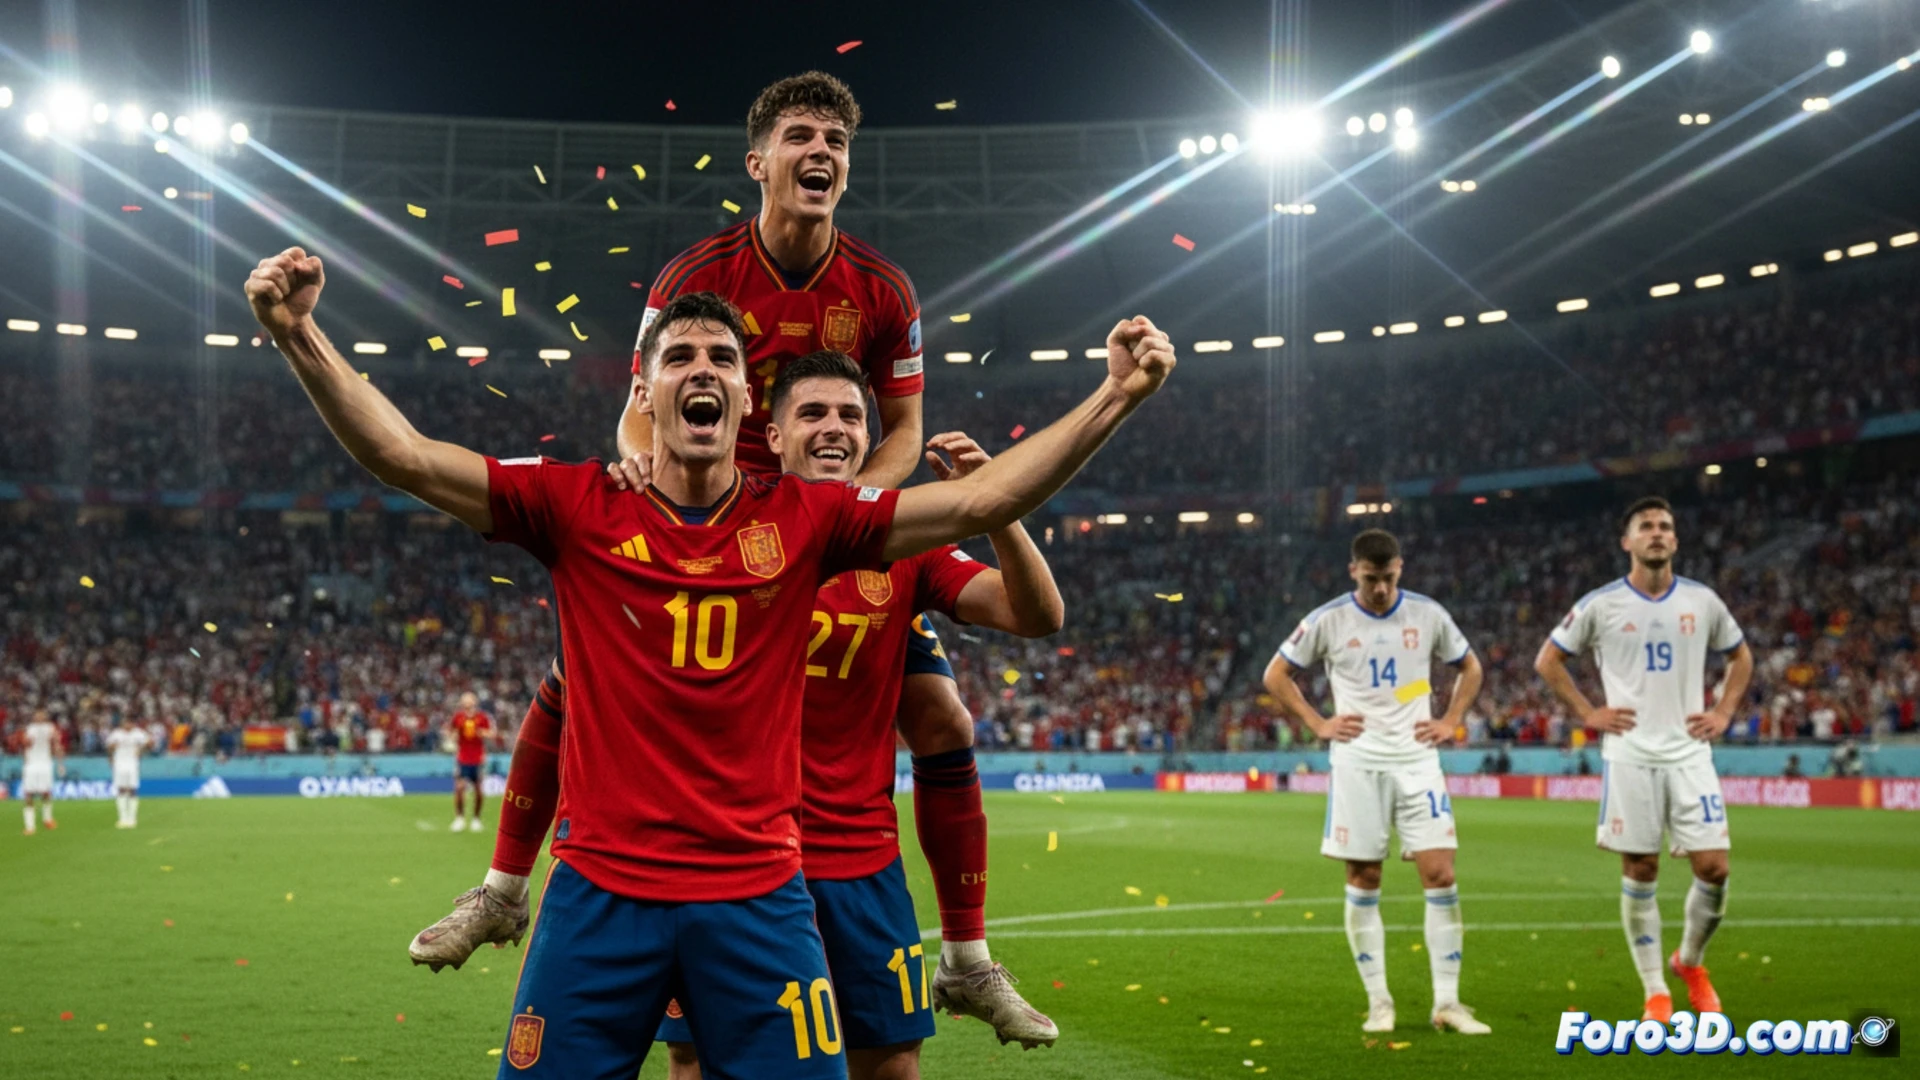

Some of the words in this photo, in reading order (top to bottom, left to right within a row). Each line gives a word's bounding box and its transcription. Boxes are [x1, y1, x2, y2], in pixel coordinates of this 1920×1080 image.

[663, 591, 738, 670] 10
[806, 610, 870, 679] 27
[1644, 641, 1673, 672] 19
[1368, 656, 1398, 688] 14
[1700, 794, 1724, 823] 19
[887, 943, 930, 1015] 17
[776, 977, 842, 1060] 10
